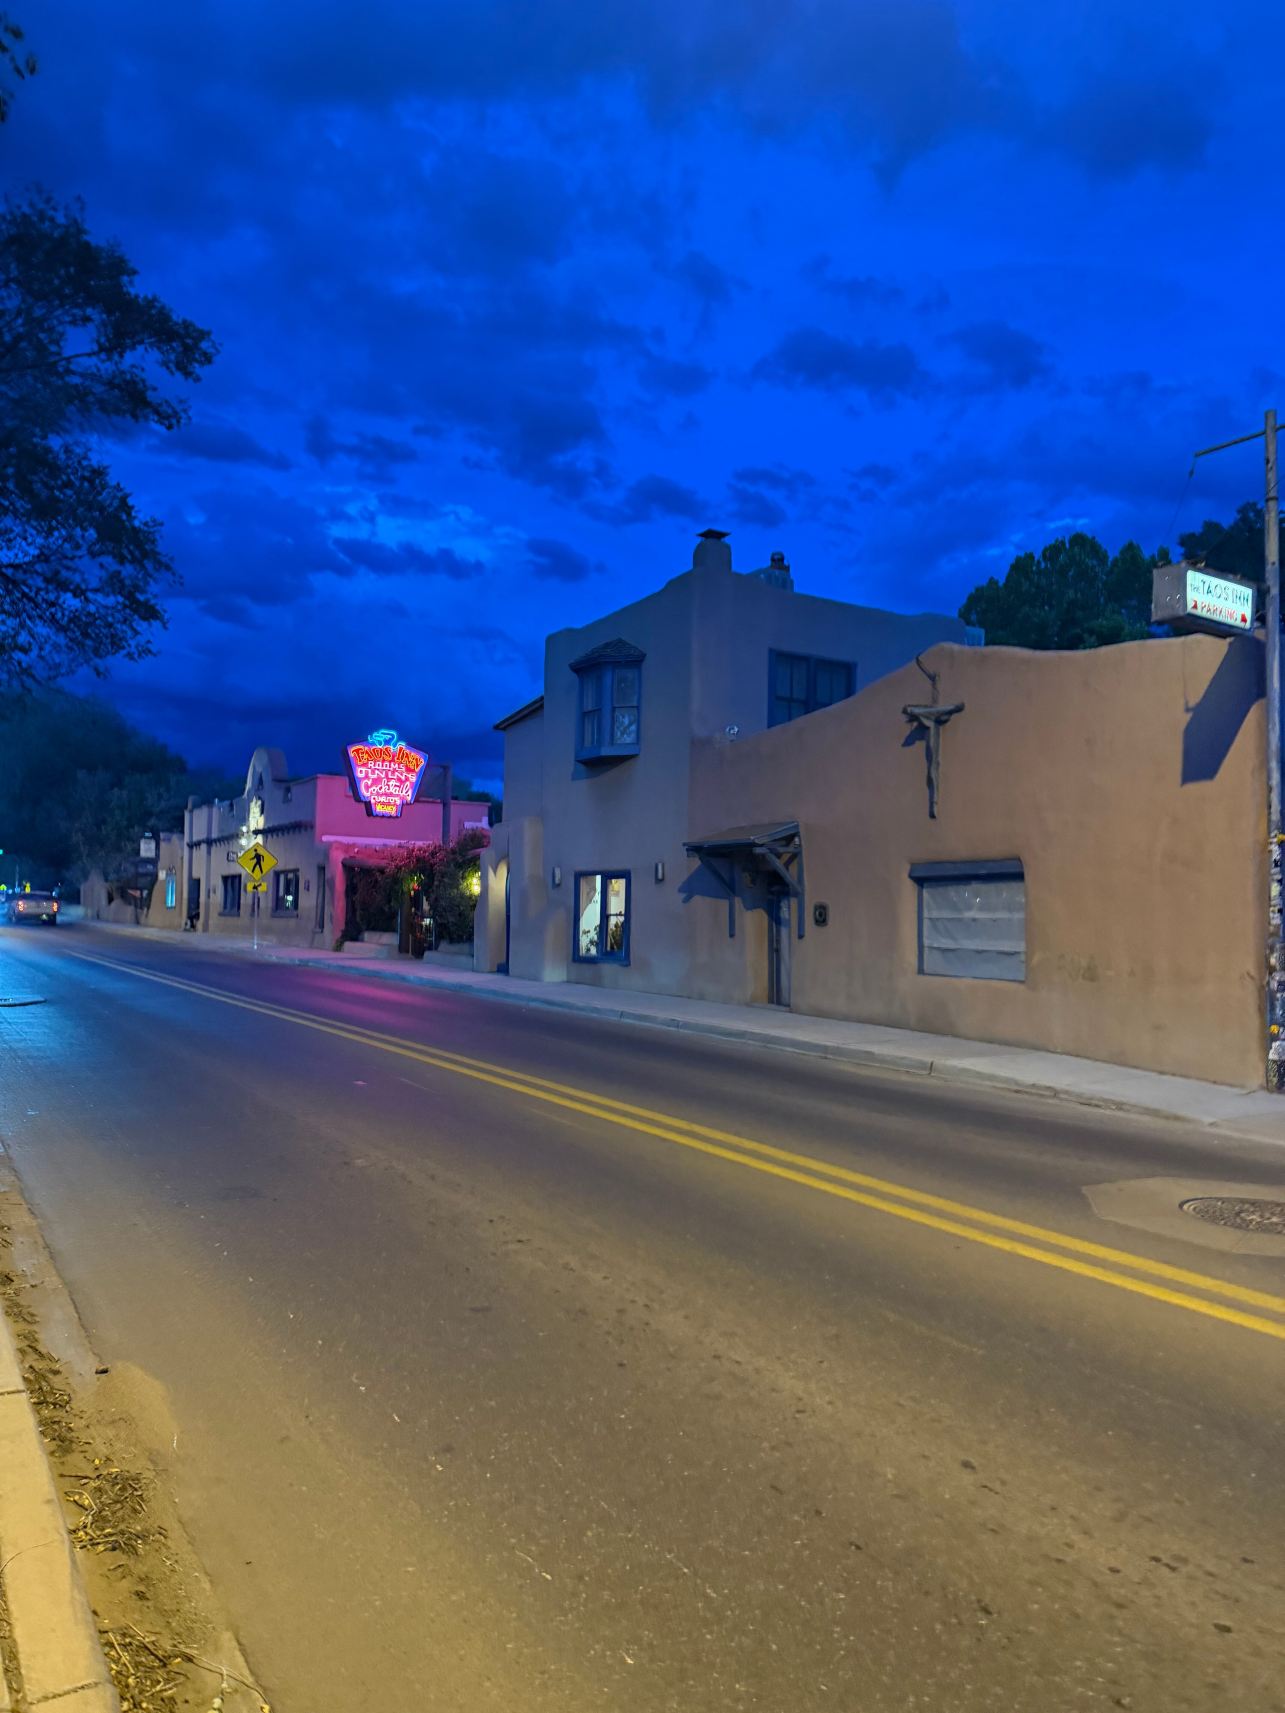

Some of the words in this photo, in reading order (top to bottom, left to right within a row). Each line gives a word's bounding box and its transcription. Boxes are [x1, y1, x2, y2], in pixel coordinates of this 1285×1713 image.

[1201, 579, 1229, 601] TAOS
[1232, 588, 1249, 608] INN
[1200, 601, 1238, 622] PARKING
[351, 745, 392, 765] TAOS
[396, 745, 424, 772] INN
[369, 761, 405, 771] ROOMS
[357, 768, 416, 782] DINING
